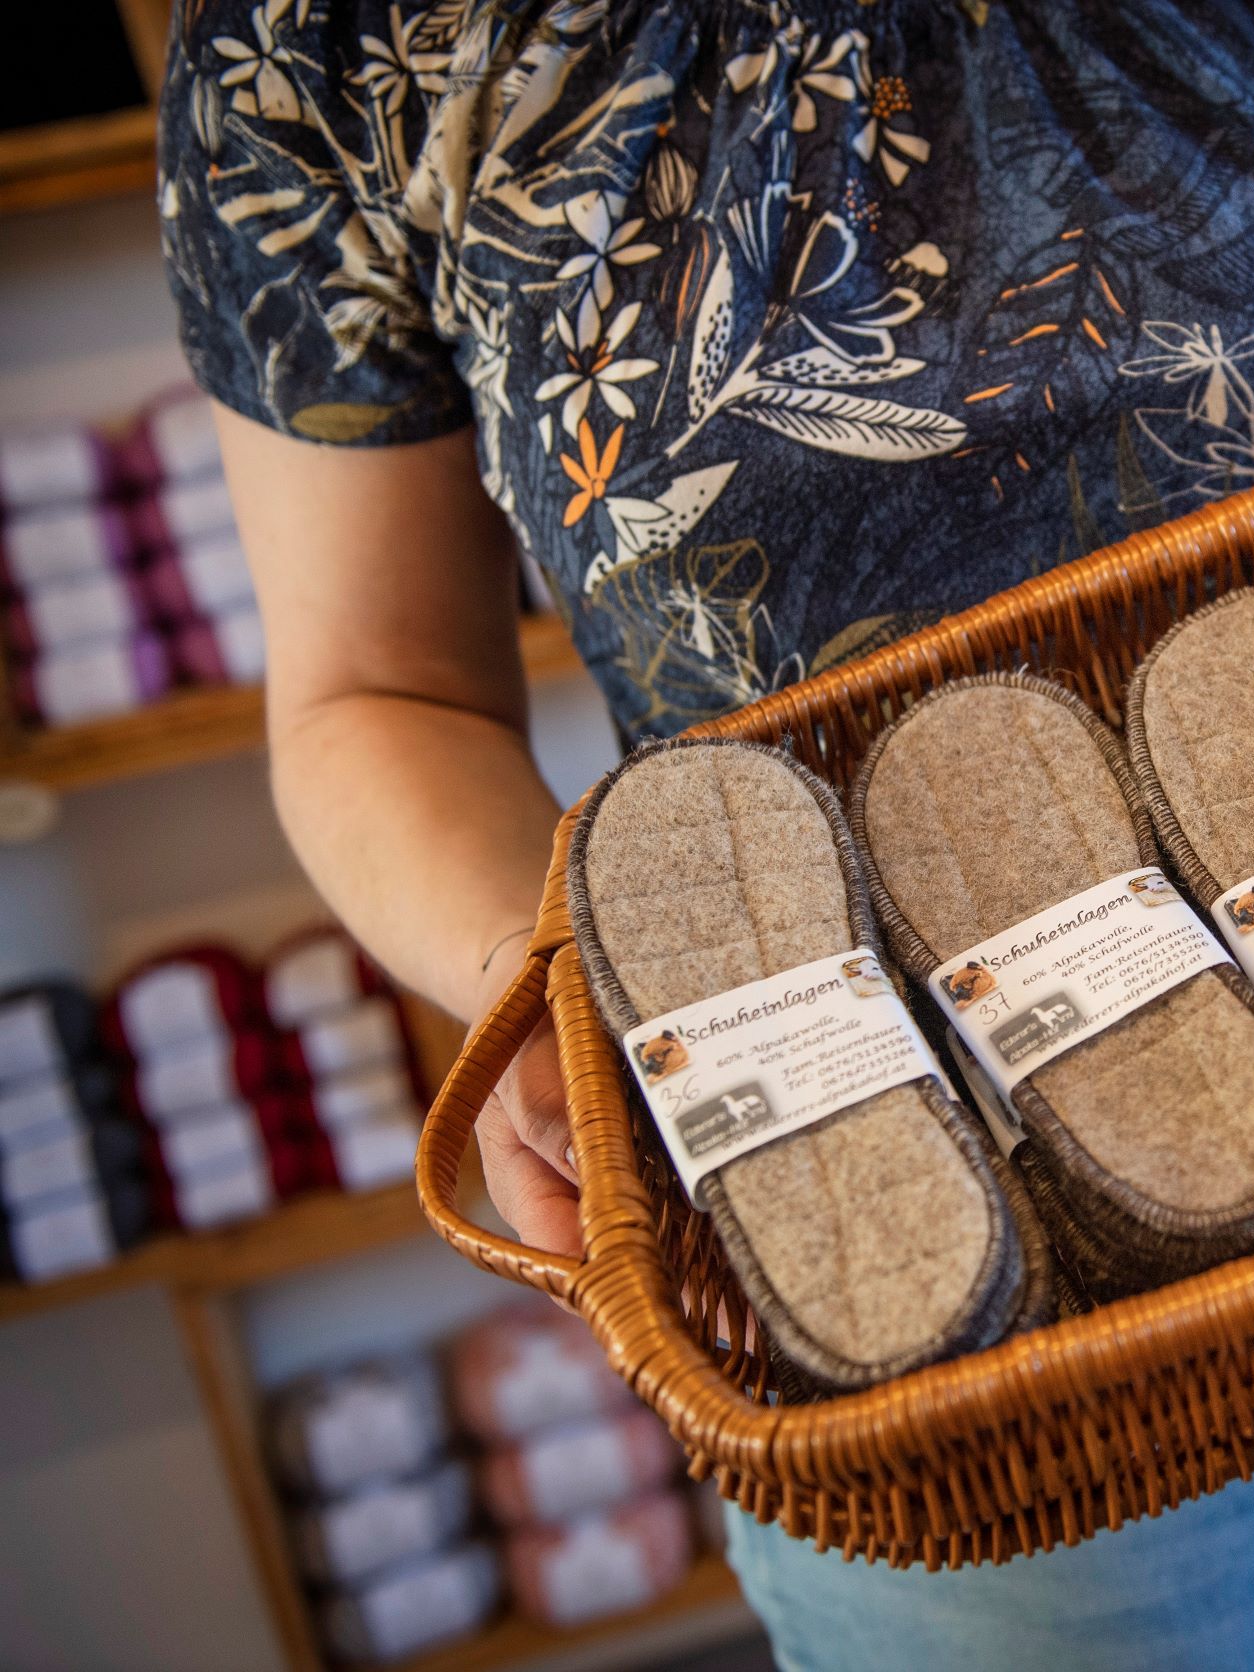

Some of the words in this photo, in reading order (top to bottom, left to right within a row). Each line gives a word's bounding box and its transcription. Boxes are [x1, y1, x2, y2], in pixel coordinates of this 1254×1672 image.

[990, 894, 1132, 972] Schuheinlagen
[1022, 970, 1047, 986] 60%
[1050, 924, 1132, 972] Alpakawolle,
[1061, 964, 1085, 978] 40%
[1088, 924, 1155, 964] Schafwolle
[1082, 922, 1194, 986] Fam.Reisenbauer
[1119, 931, 1204, 980] 0676/5134590
[1124, 940, 1210, 988] 0676/7355266
[688, 976, 844, 1046] Schuheinlagen
[979, 992, 1008, 1025] 37
[1038, 954, 1203, 1054] www.ederers-alpakahof.at
[717, 1051, 744, 1068] 60%
[749, 1015, 839, 1057] Alpakawolle,
[788, 1018, 862, 1051] Schafwolle
[661, 1074, 699, 1118] 36
